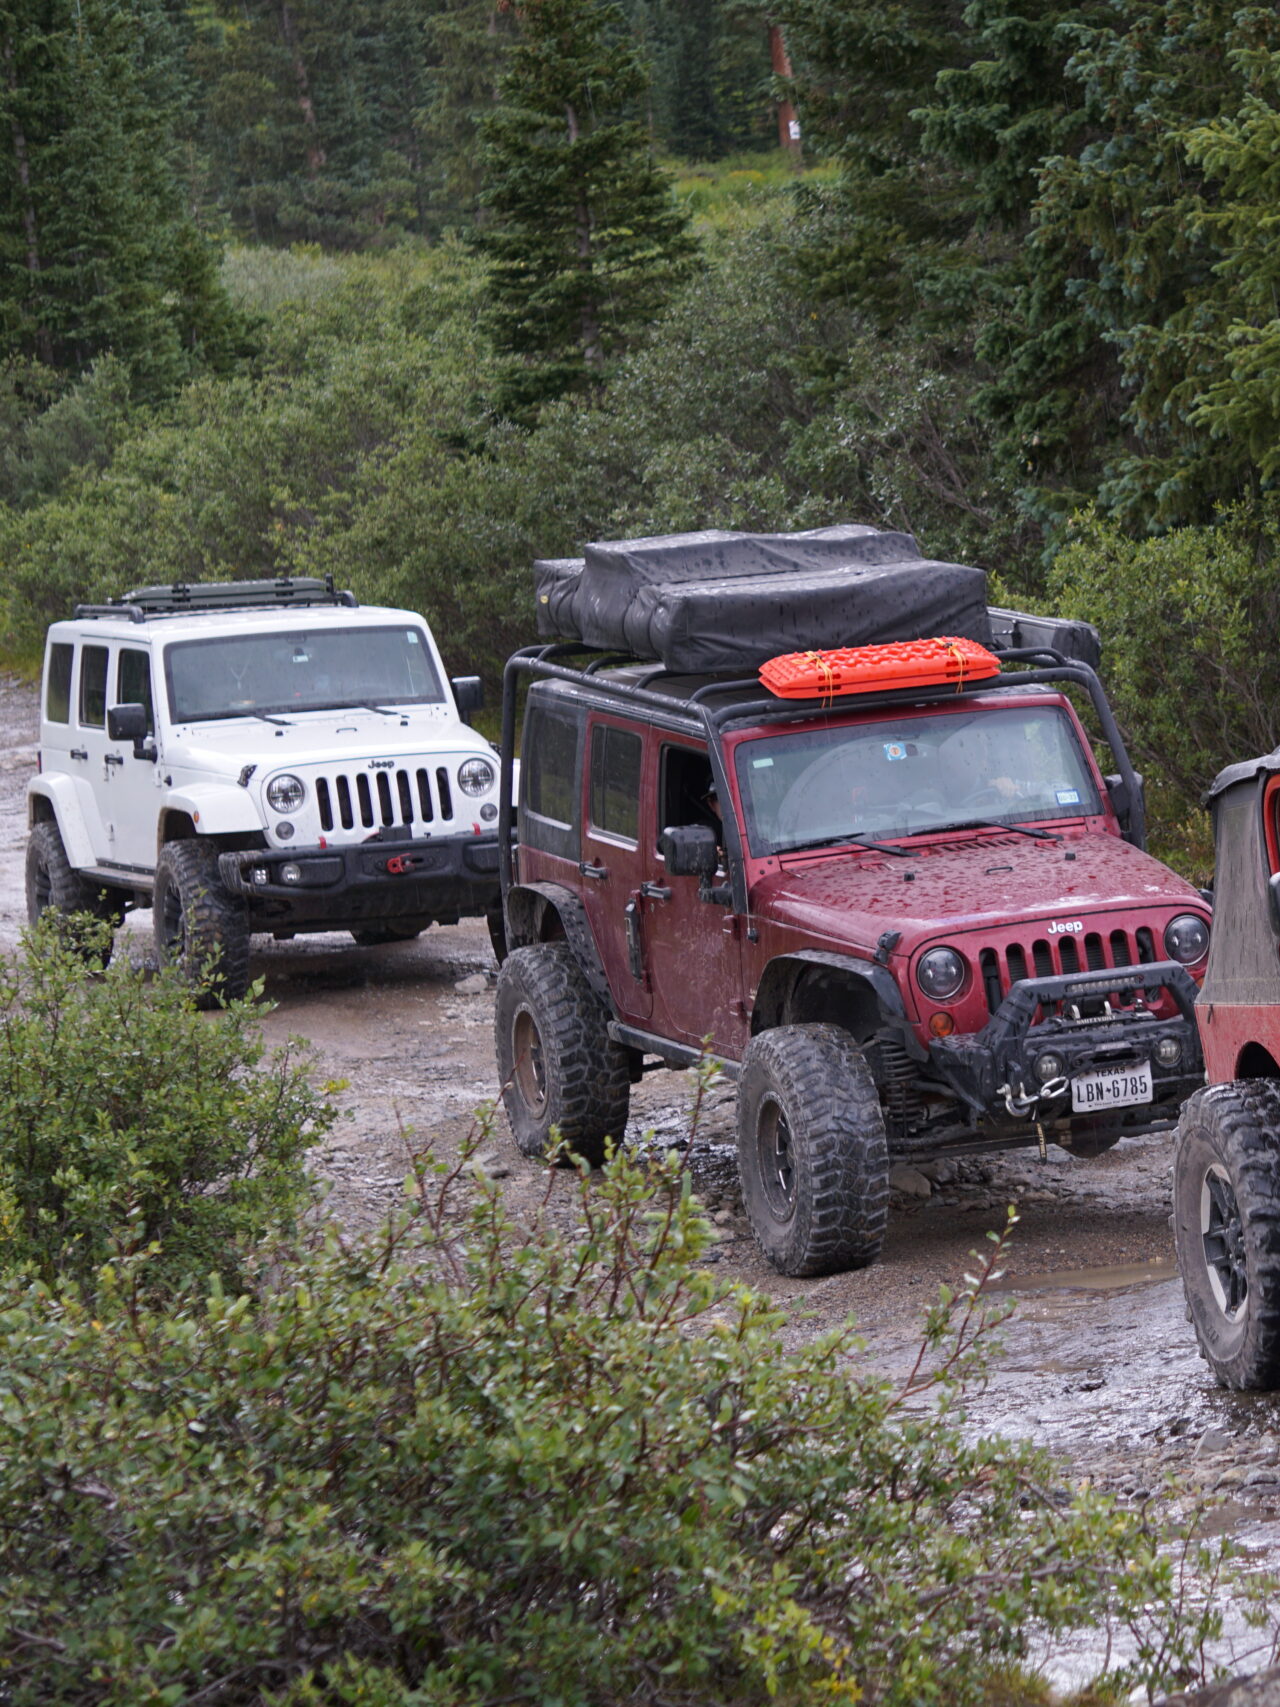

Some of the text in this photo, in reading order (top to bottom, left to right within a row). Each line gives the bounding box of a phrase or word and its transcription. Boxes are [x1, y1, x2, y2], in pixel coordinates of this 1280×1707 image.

[368, 760, 395, 769] Jeep
[1048, 921, 1083, 934] Jeep
[1096, 1066, 1126, 1078] TEXAS
[1077, 1075, 1148, 1104] LBN 6785
